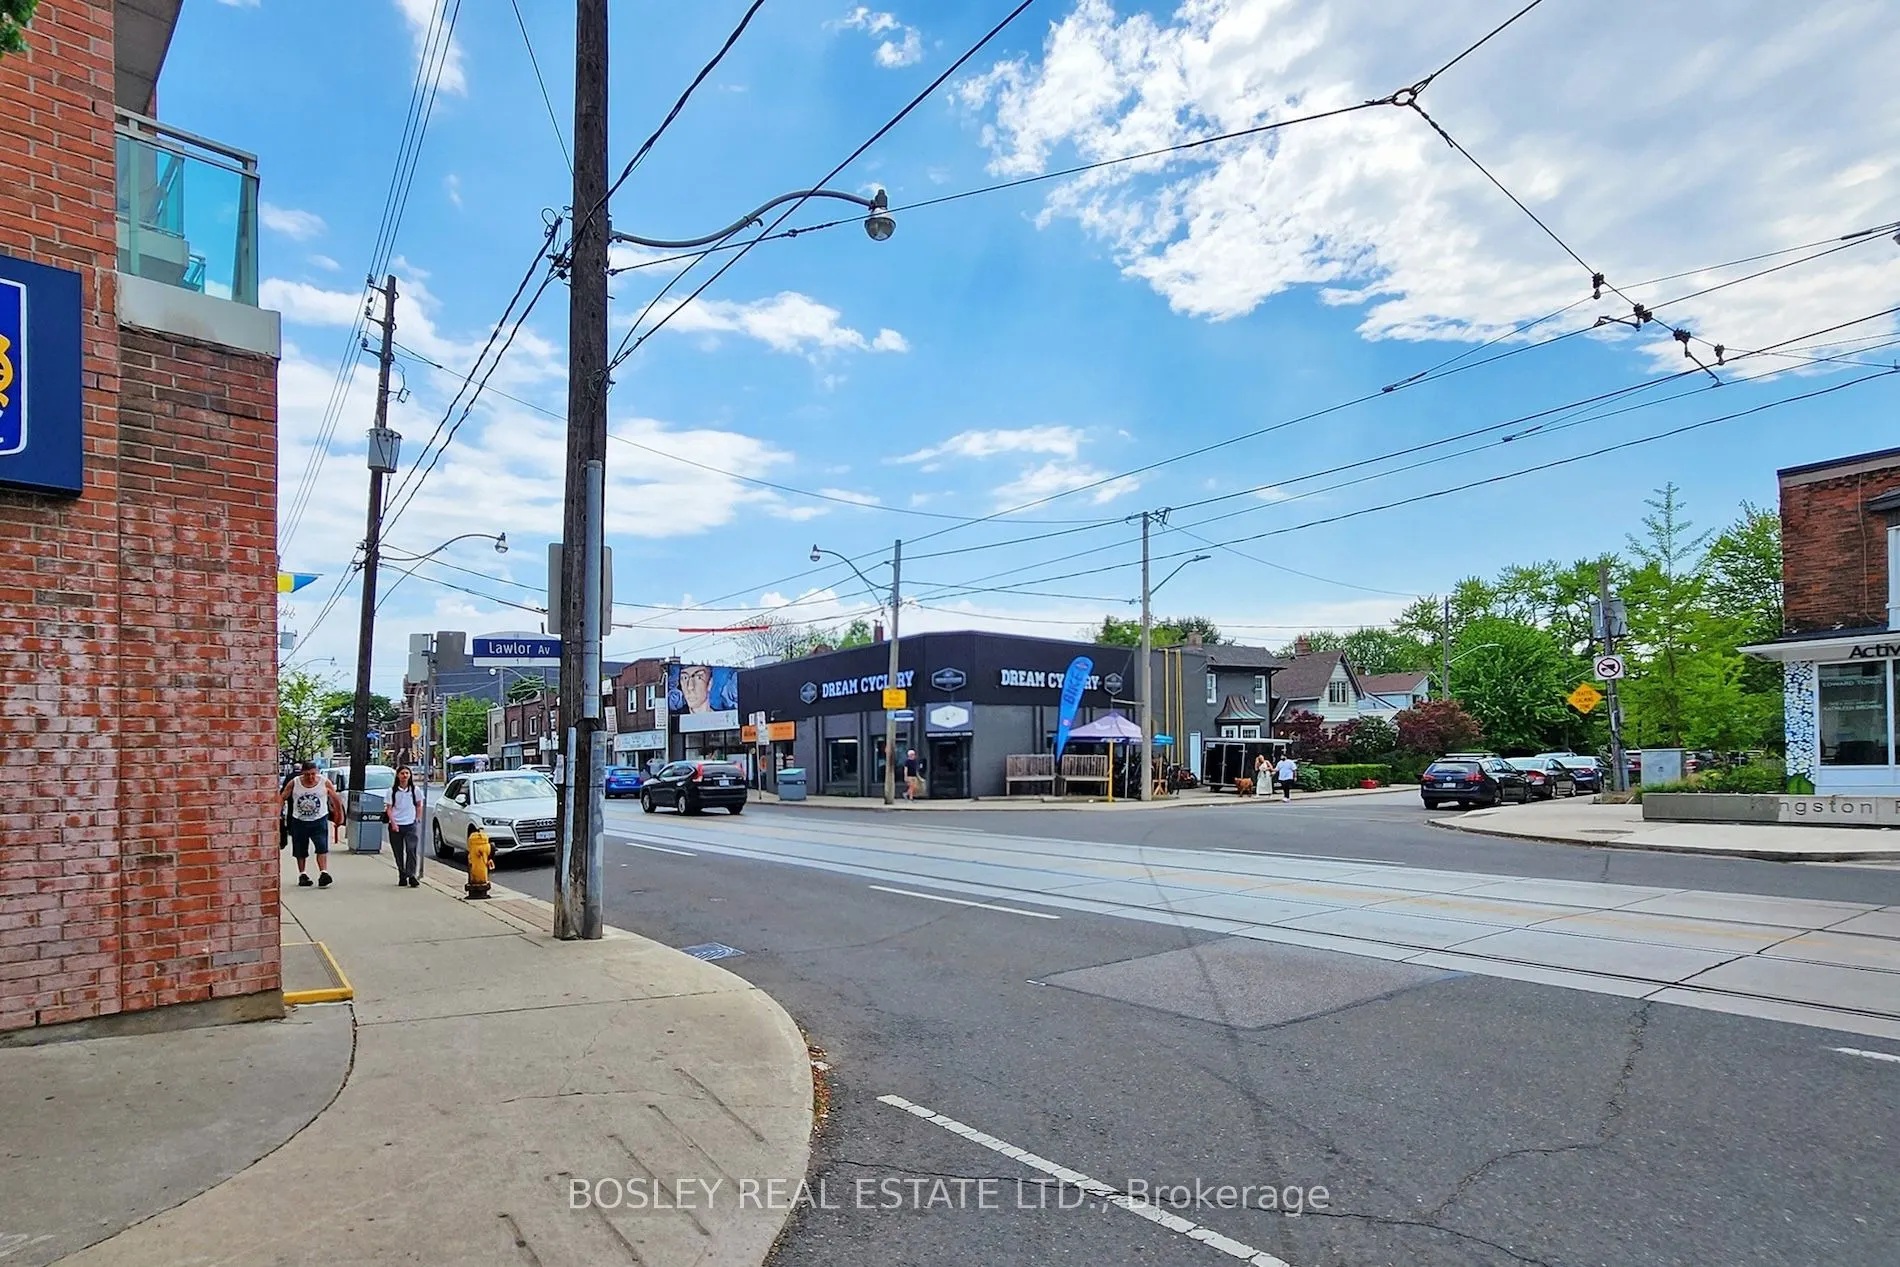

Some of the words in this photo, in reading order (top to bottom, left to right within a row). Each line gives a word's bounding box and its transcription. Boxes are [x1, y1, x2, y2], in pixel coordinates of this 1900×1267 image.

[488, 641, 532, 654] Lawlor
[537, 644, 550, 655] Av
[822, 679, 858, 698] DREAM
[860, 670, 914, 693] CYCLRY
[1001, 669, 1045, 687] DREAM
[1047, 672, 1099, 690] CYRY
[1751, 797, 1872, 815] Kngston
